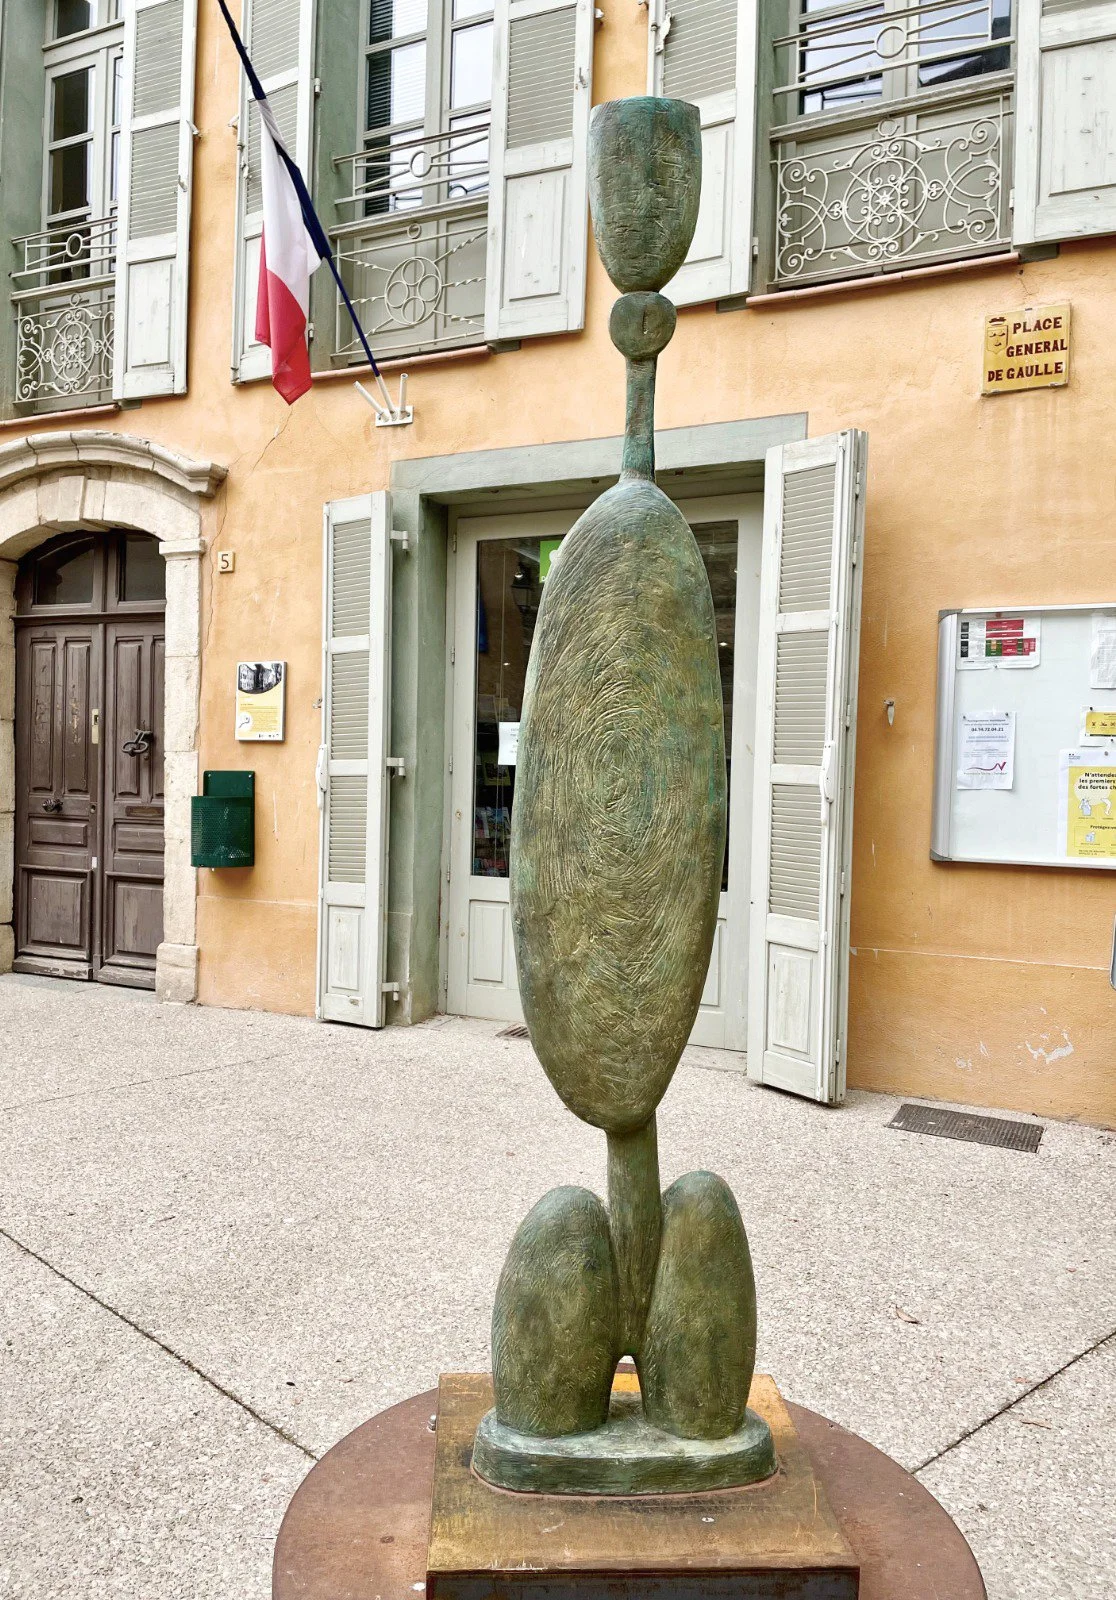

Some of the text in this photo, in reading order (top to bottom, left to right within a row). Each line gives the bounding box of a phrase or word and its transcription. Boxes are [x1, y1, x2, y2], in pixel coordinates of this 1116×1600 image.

[1012, 316, 1062, 335] PLACE
[1006, 338, 1067, 358] GENERAL
[987, 361, 1063, 382] DE GAULLE
[220, 553, 230, 570] 5
